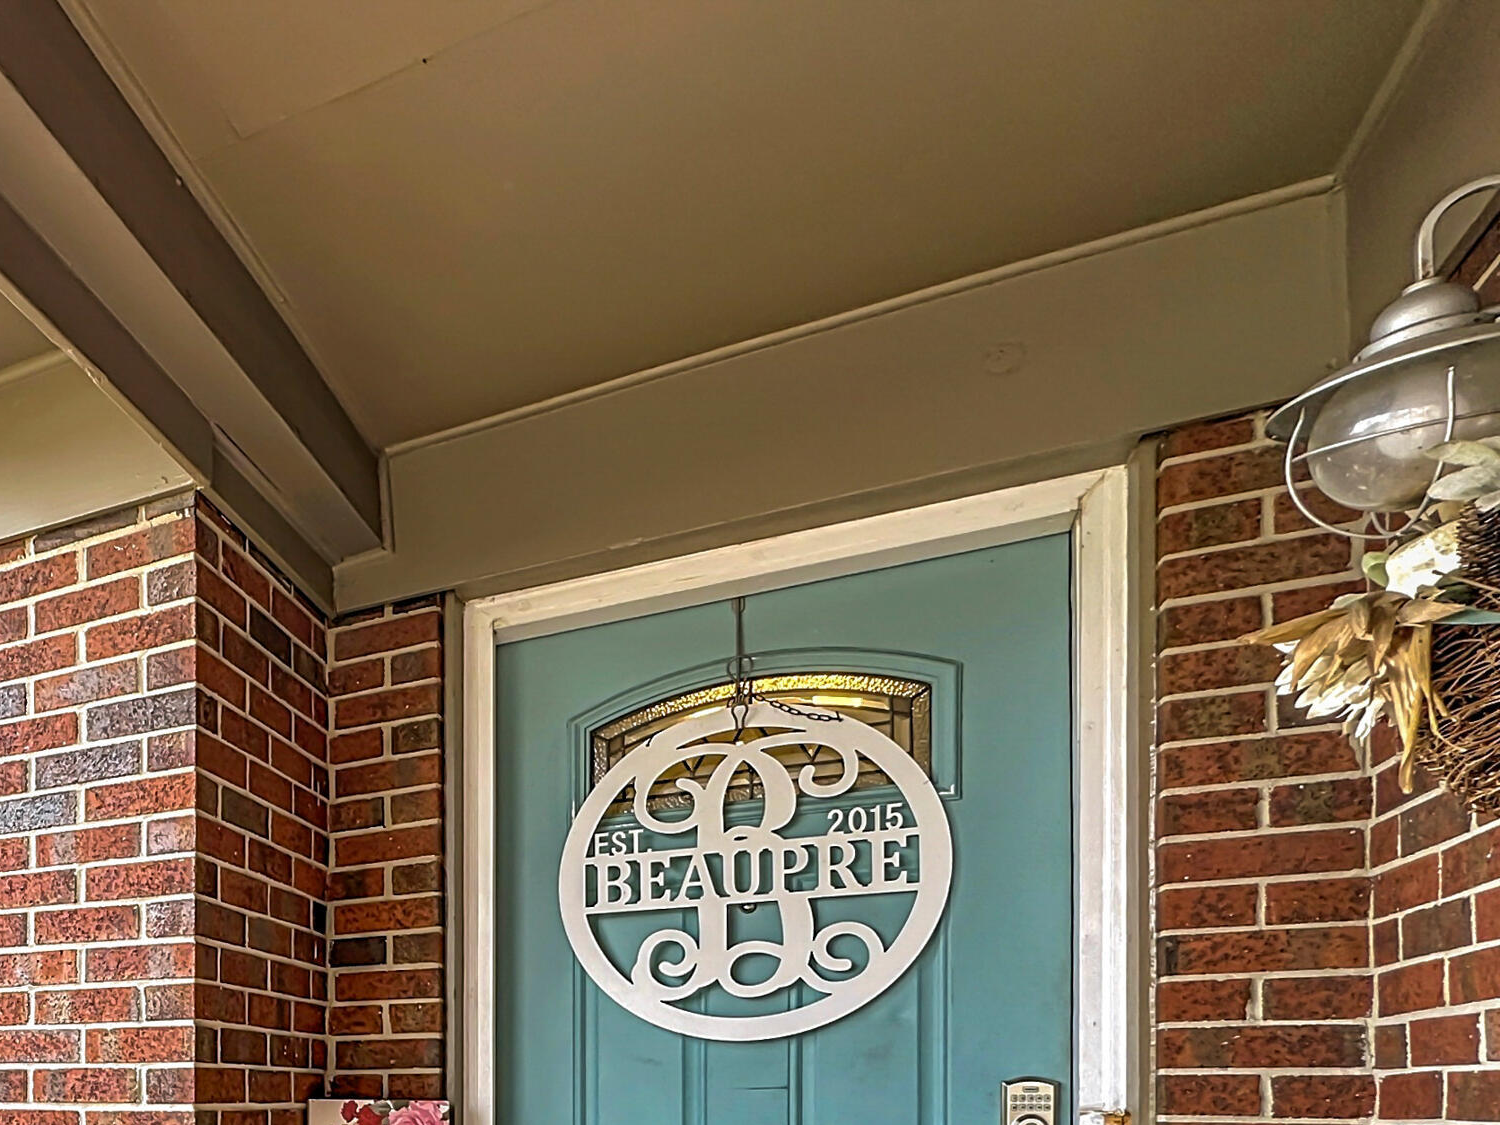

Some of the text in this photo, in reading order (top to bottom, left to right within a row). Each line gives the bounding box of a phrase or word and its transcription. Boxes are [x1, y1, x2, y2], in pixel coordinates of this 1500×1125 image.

[826, 802, 905, 836] 2015
[594, 828, 653, 857] EST.
[595, 836, 910, 907] BEAUPRE
